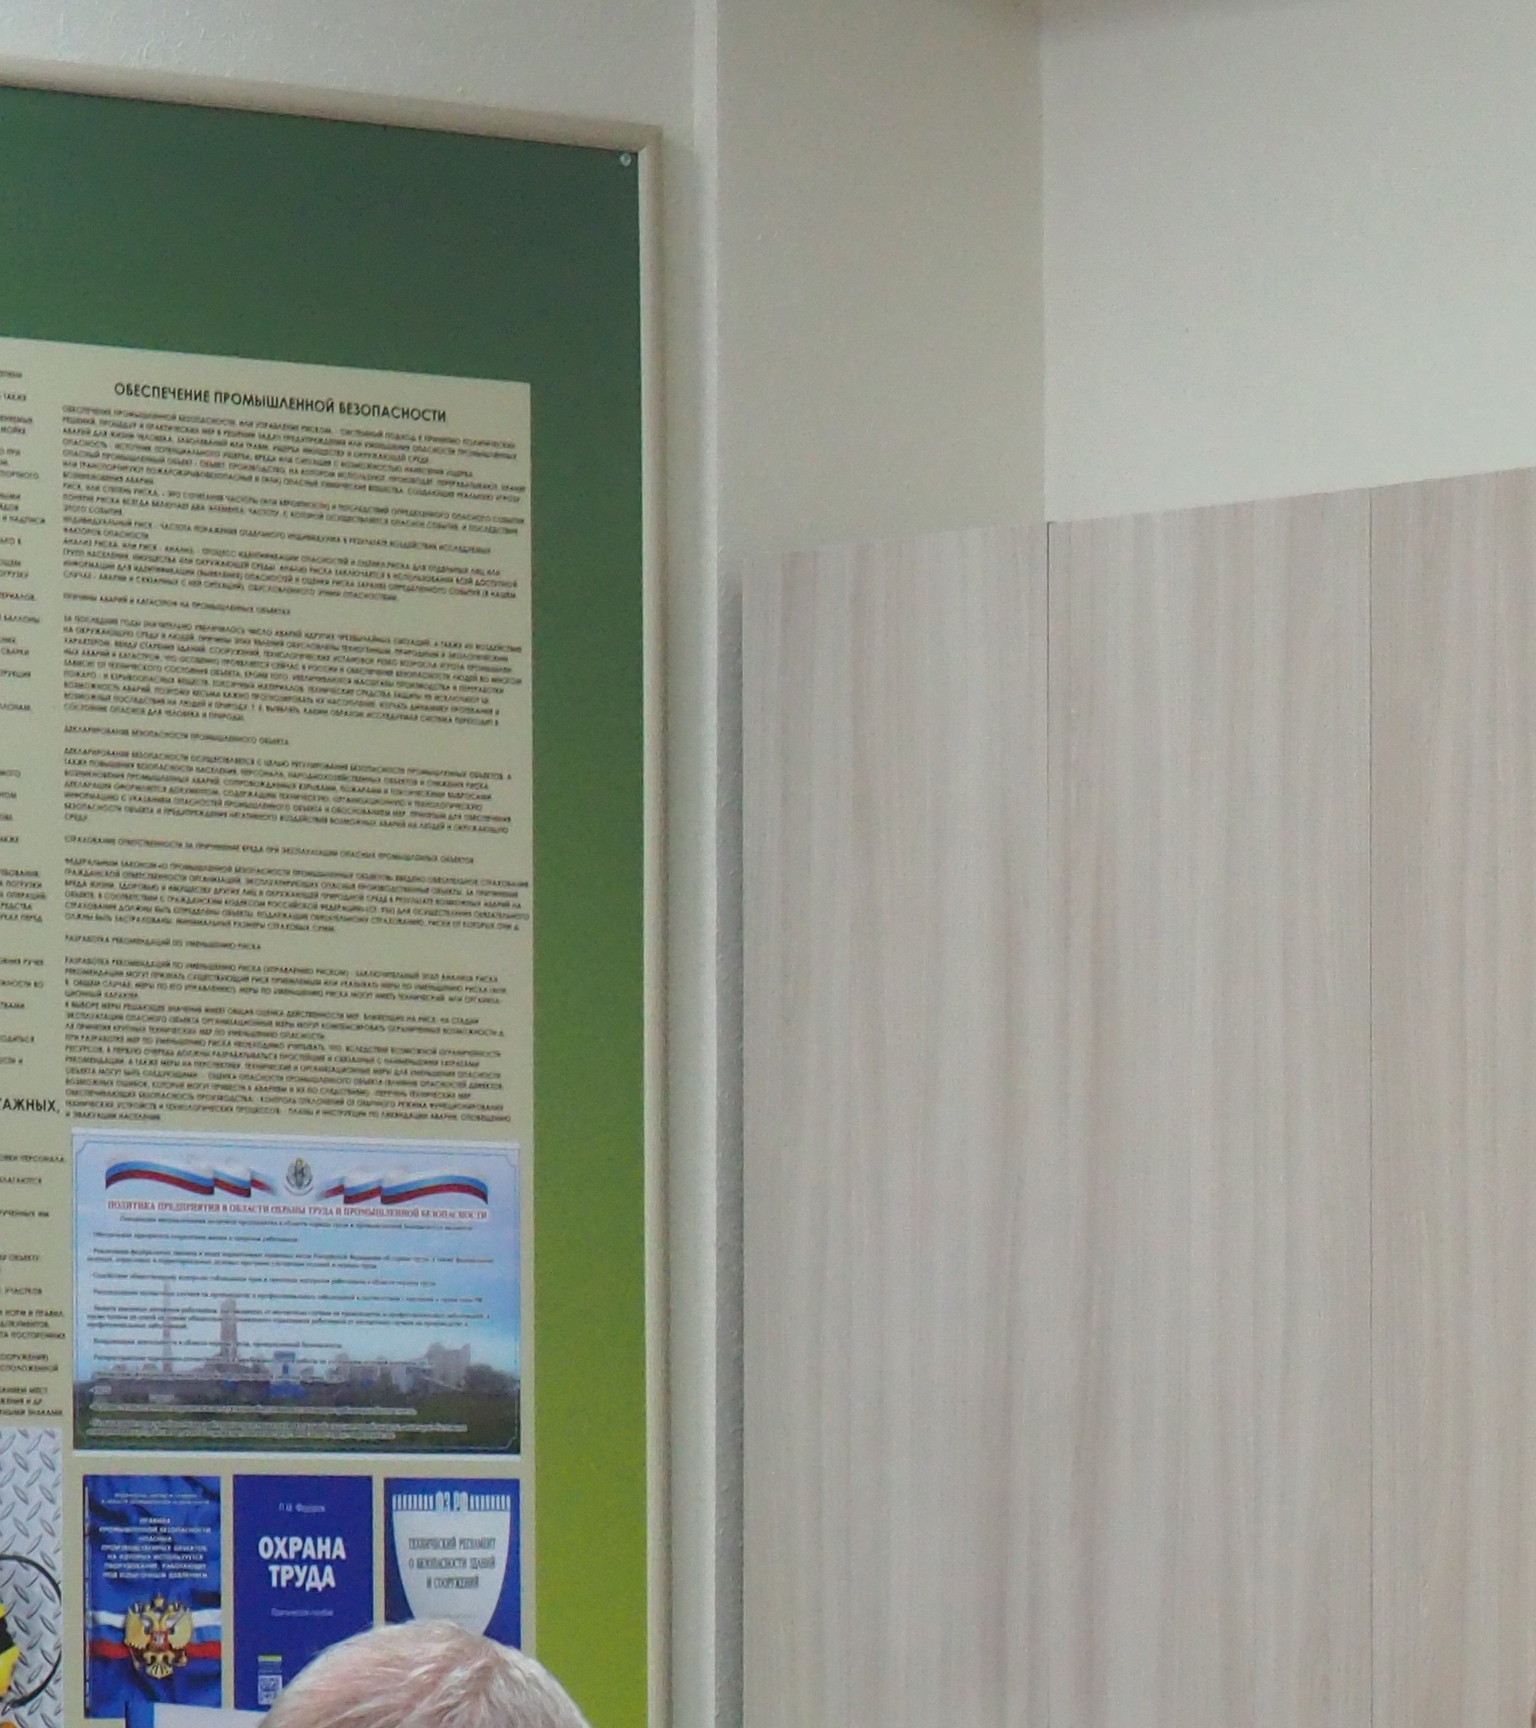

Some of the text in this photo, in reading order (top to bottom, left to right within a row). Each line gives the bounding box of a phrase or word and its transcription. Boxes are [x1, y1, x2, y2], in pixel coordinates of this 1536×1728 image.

[114, 382, 446, 422] ОБЕСПЕЧЕНИЕ ПРОМЫШЛЕННОЙ БЕЗОПАСНОСТИ
[108, 1201, 155, 1210] ПОЛИТИКА
[158, 1202, 220, 1212] ПРЕДПРИЯТИЯ
[230, 1204, 269, 1213] ОБЛАСТИ
[271, 1205, 306, 1214] ОХРАНЫ
[308, 1207, 334, 1216] ТРУДА
[344, 1208, 419, 1218] ПРОМЫШЛЕННОЙ
[422, 1210, 487, 1219] БЕЗОПАСНОСТИ
[258, 1536, 346, 1560] ОХРАНА
[268, 1565, 336, 1592] ТРУДА
